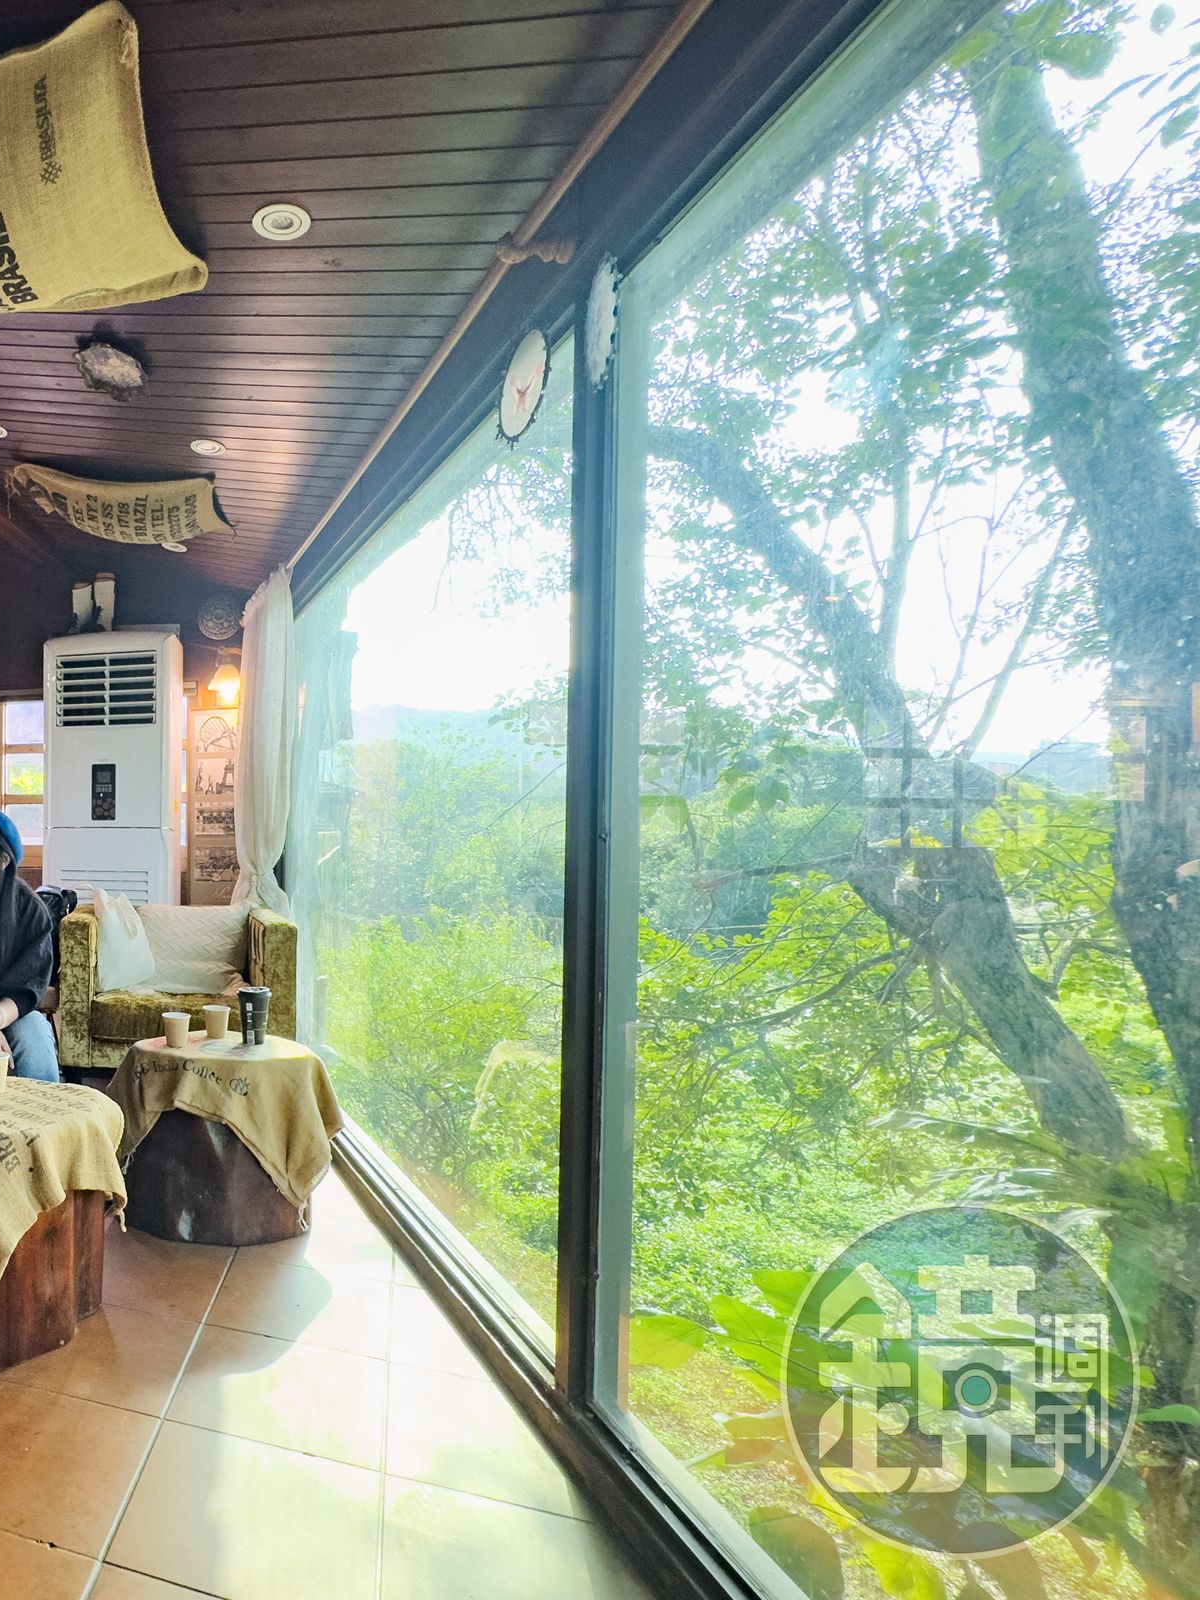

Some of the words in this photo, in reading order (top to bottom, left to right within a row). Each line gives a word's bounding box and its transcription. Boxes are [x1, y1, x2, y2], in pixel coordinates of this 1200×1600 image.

[132, 494, 149, 538] BRAZIL
[152, 1060, 179, 1073] India
[182, 1059, 222, 1085] Coffee
